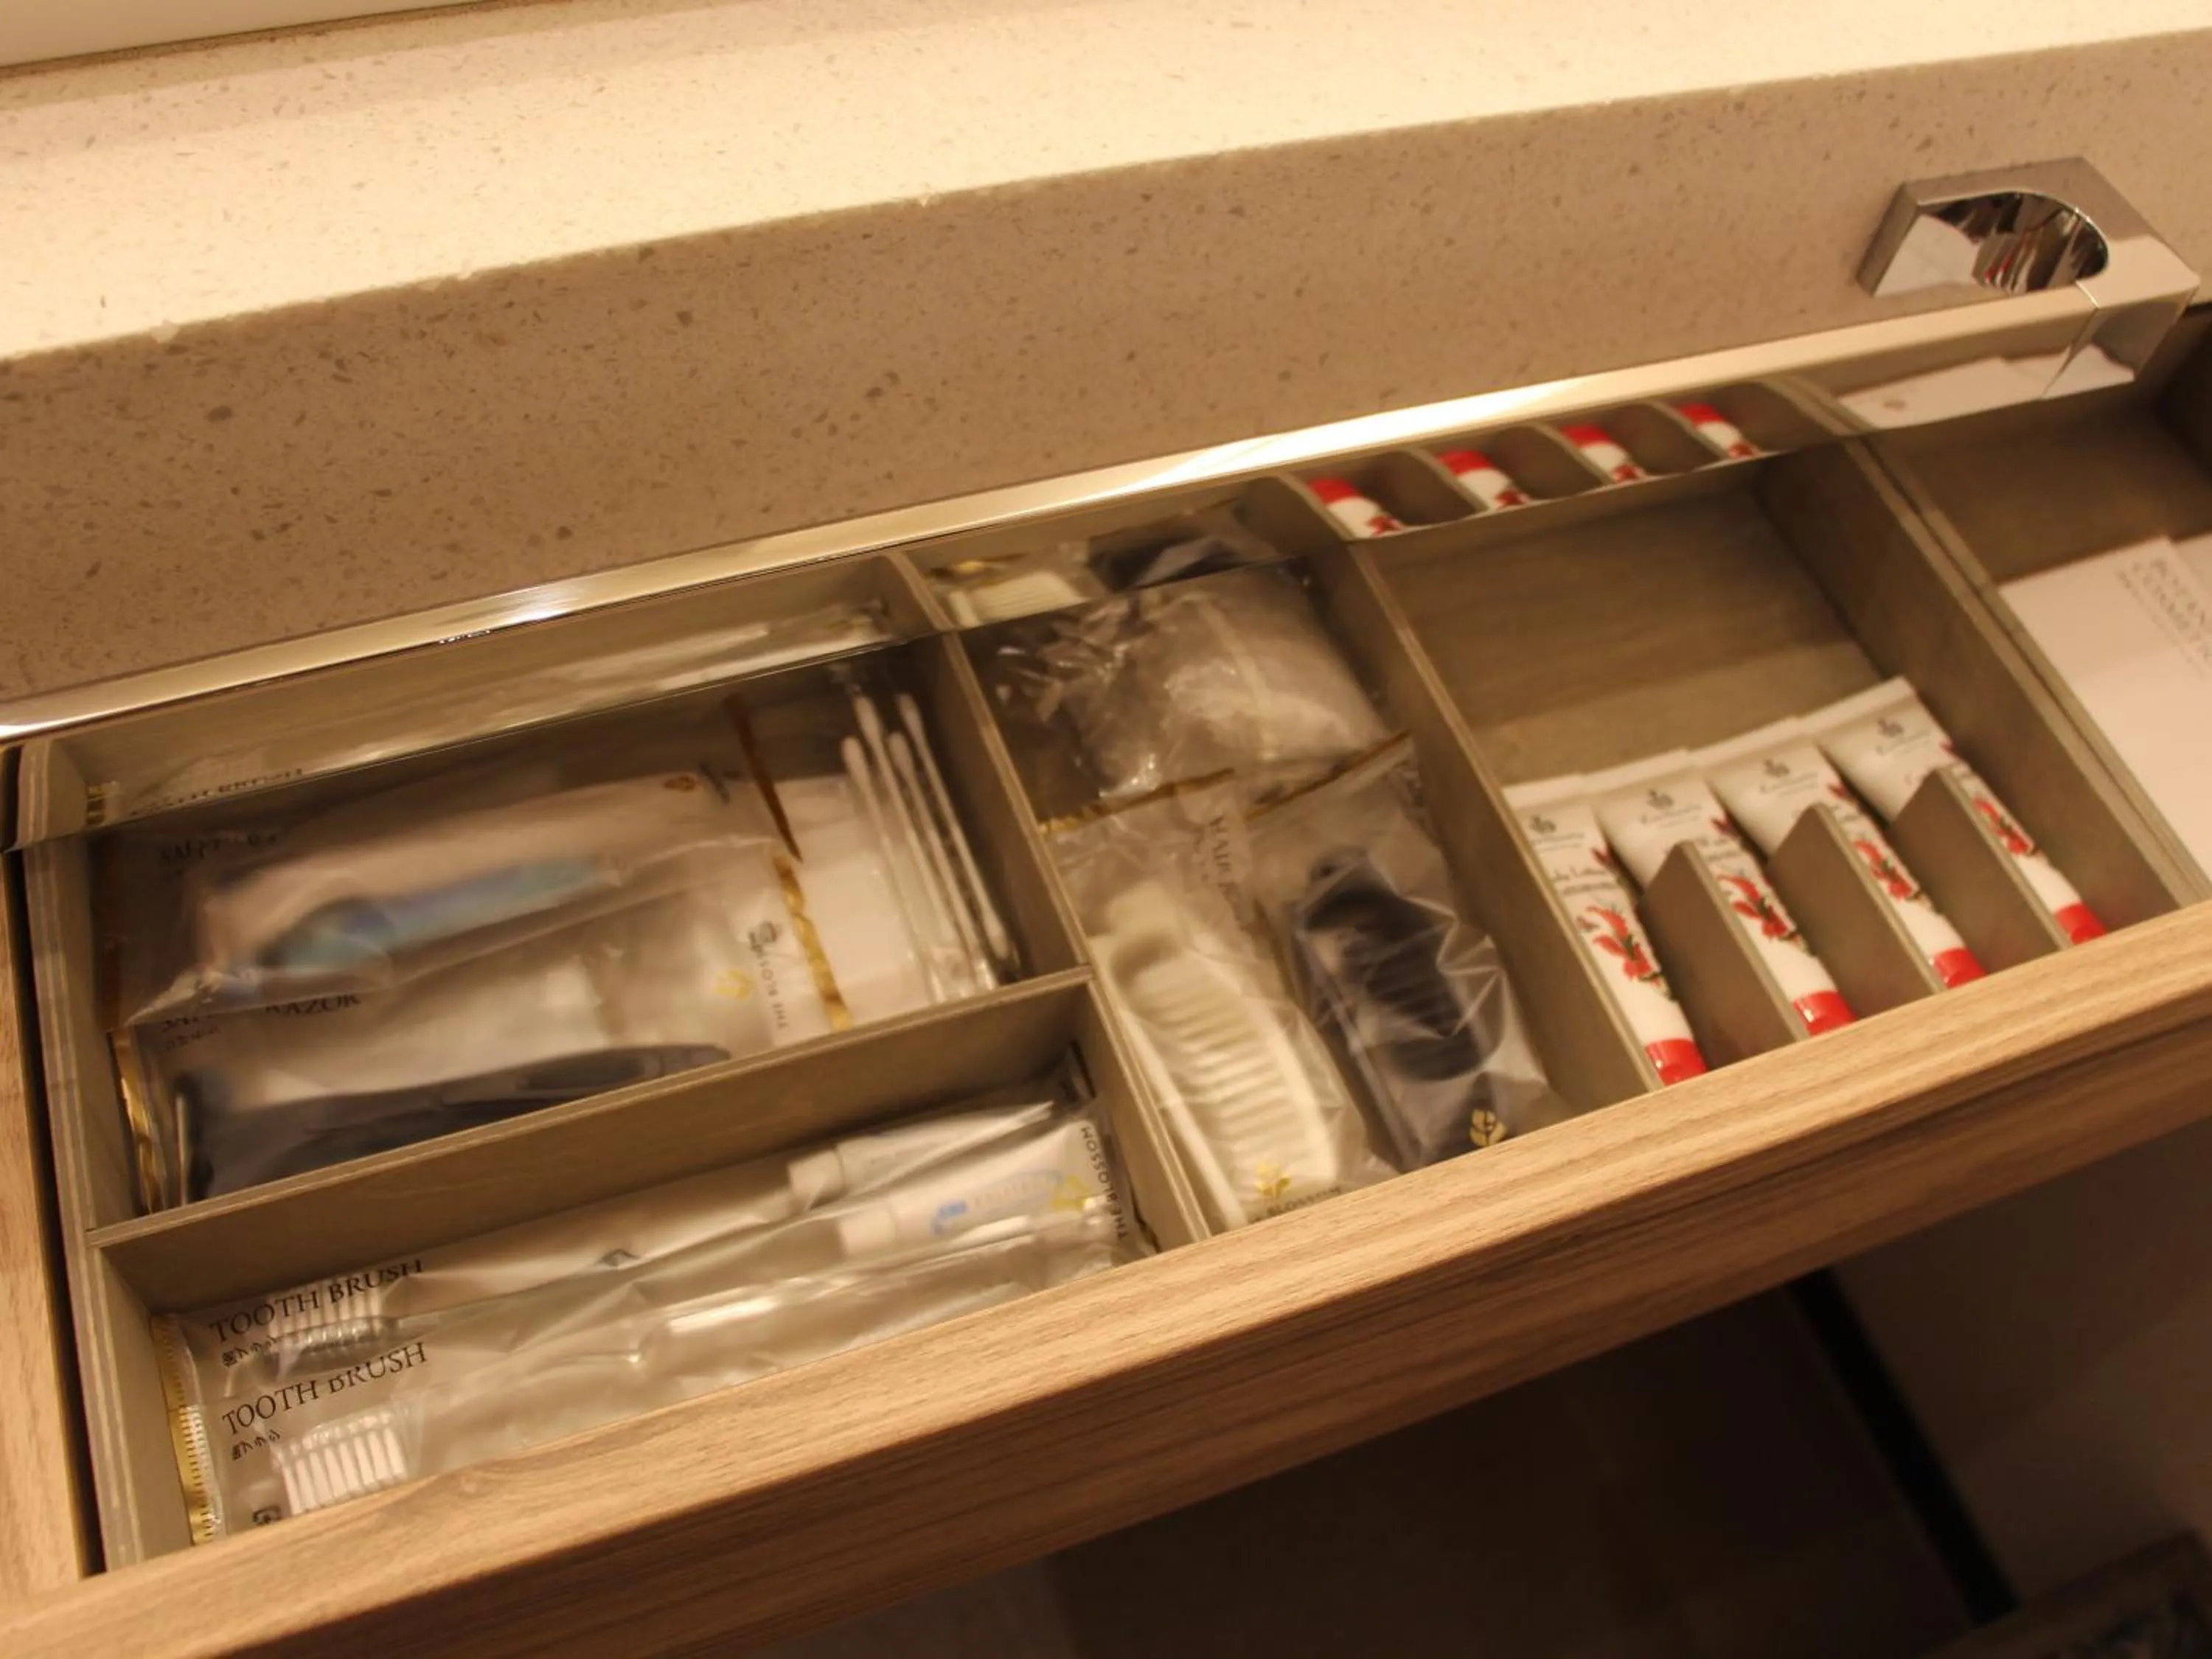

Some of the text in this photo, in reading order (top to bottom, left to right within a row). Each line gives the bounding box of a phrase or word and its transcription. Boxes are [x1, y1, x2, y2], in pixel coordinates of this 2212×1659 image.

[1081, 1126, 1129, 1240] THE BLOSSOM
[209, 1259, 423, 1343] TOOTH BRUSH
[222, 1379, 320, 1436] TOOTH
[329, 1340, 428, 1394] BRUSH
